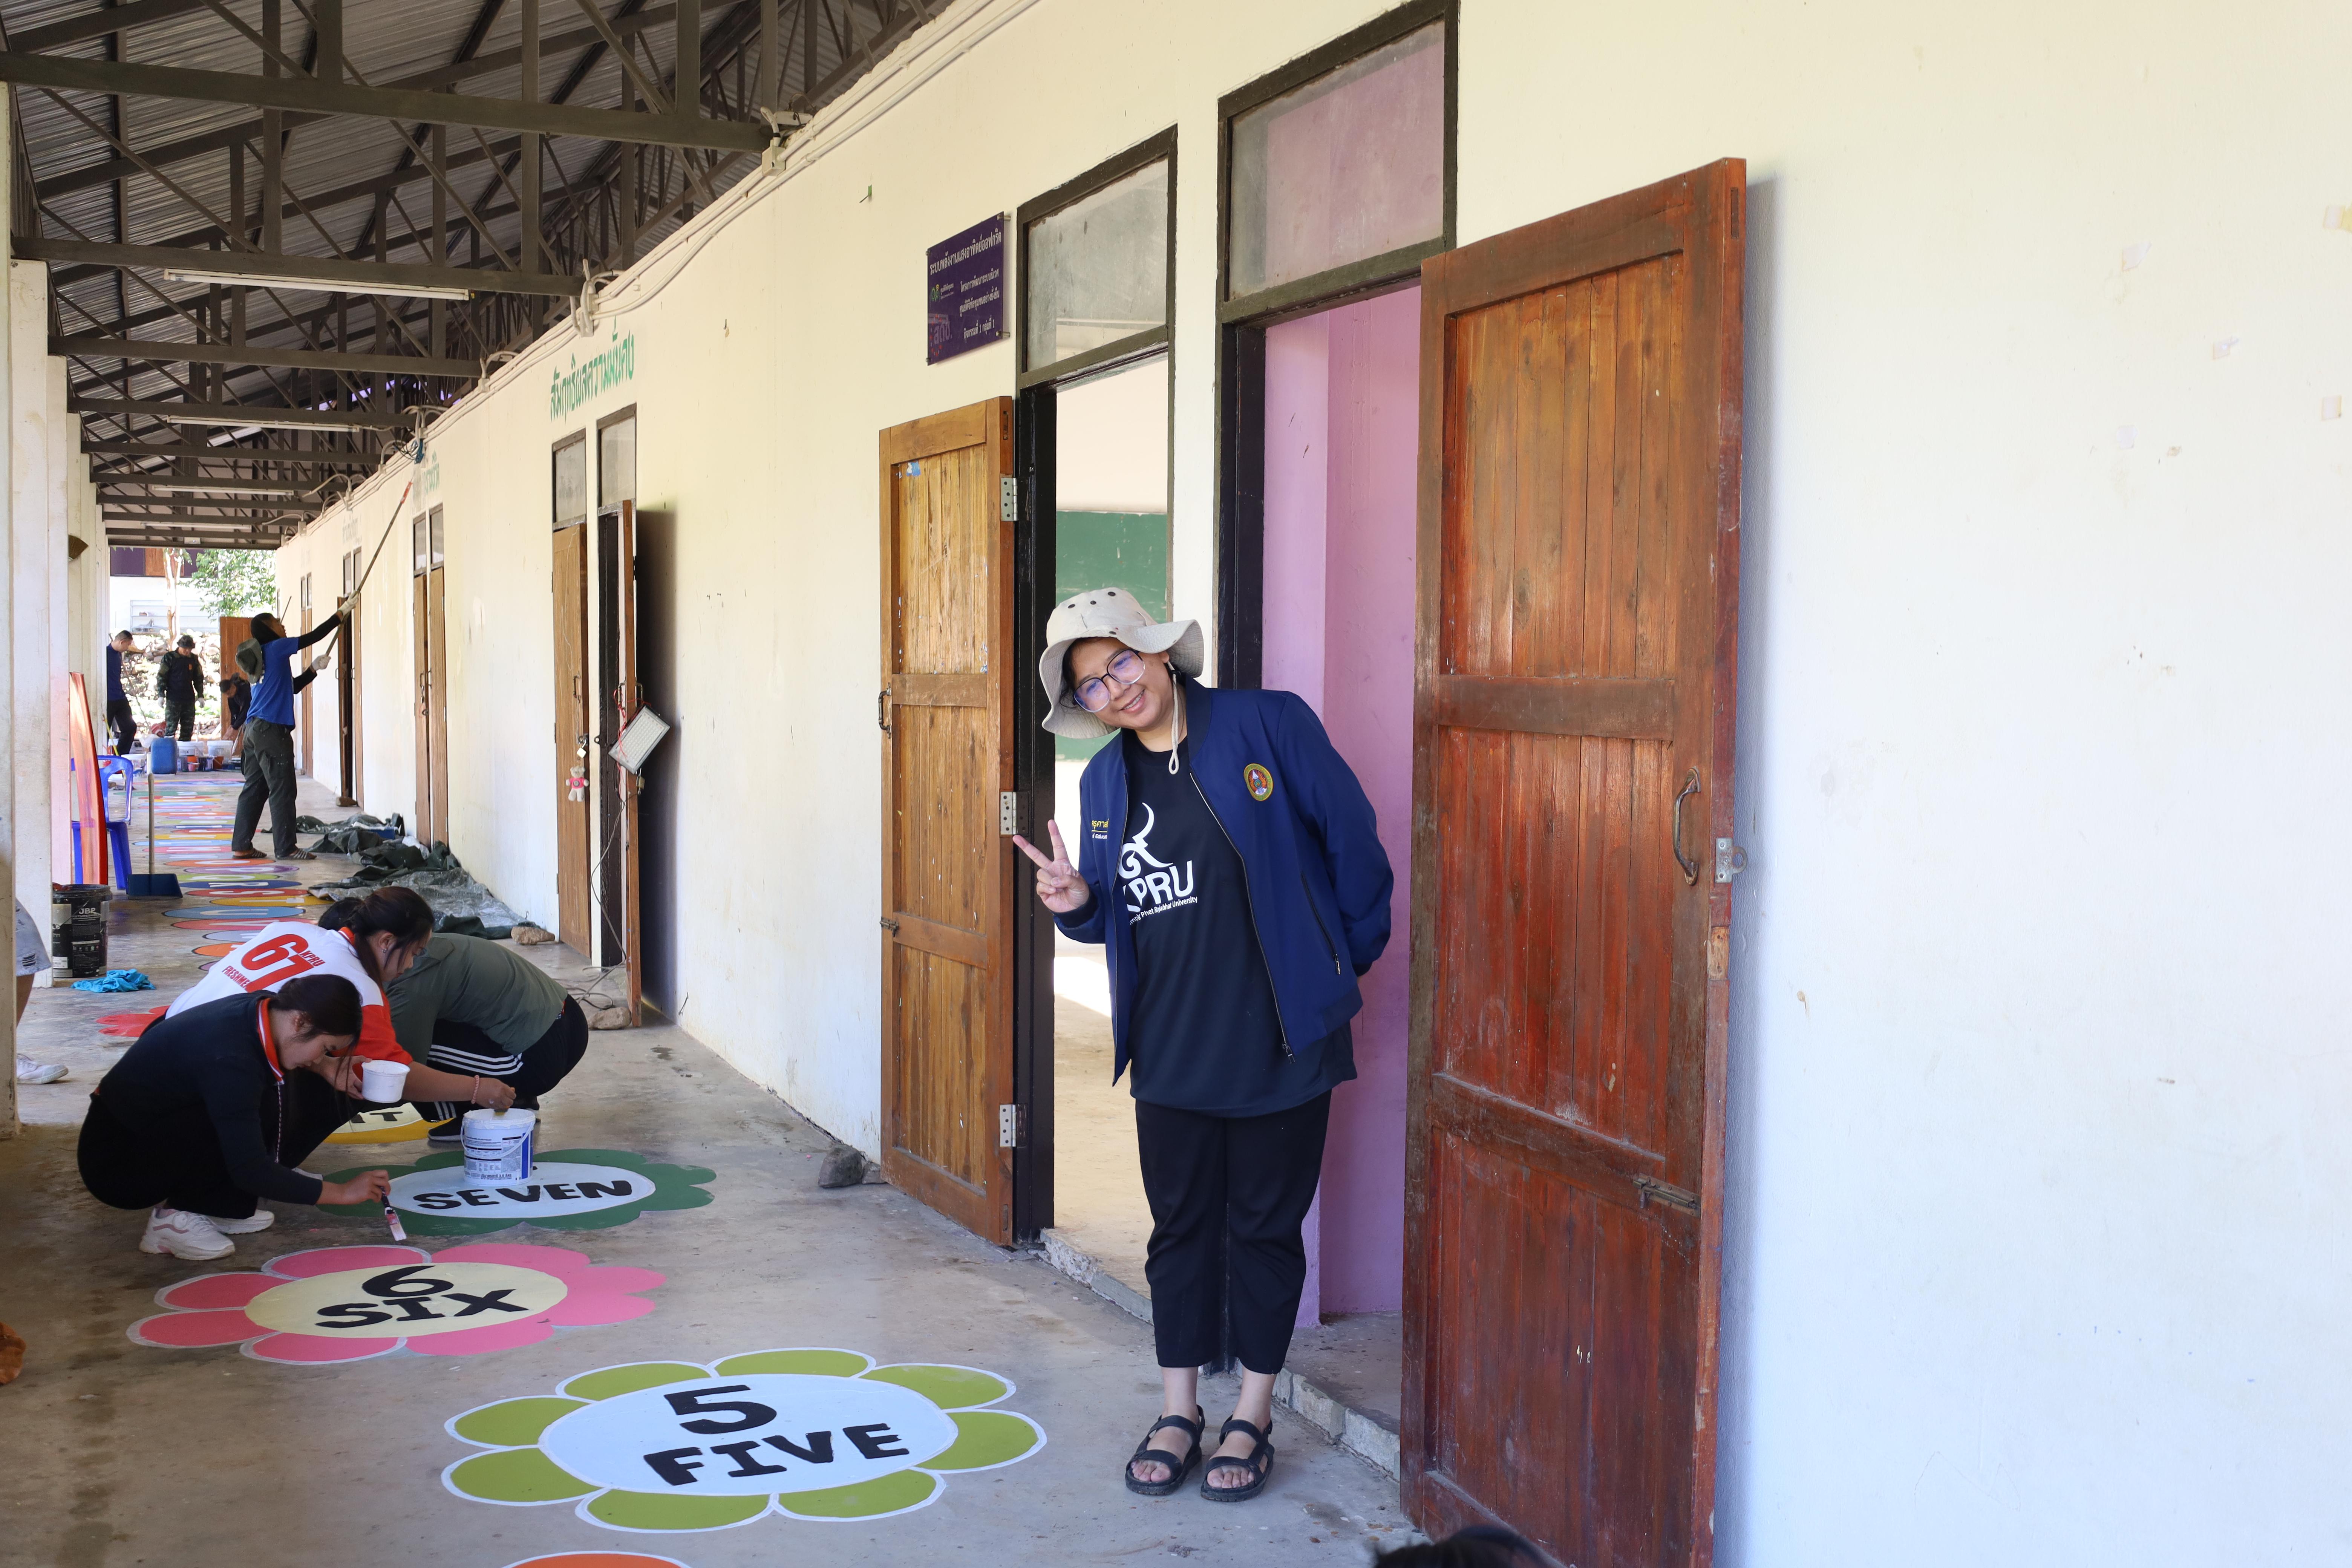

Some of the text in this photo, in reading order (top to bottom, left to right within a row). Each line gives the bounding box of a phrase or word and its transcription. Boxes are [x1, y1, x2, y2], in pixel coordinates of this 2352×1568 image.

[1122, 860, 1194, 913] PRU
[1141, 896, 1197, 917] Phet Rajabhat University
[241, 934, 315, 993] 67
[299, 951, 326, 967] KPRU
[413, 1180, 632, 1209] SEVEN
[362, 1265, 454, 1298] 6
[315, 1289, 530, 1329] SIX
[664, 1384, 778, 1435] 5
[643, 1423, 910, 1487] FIVE
